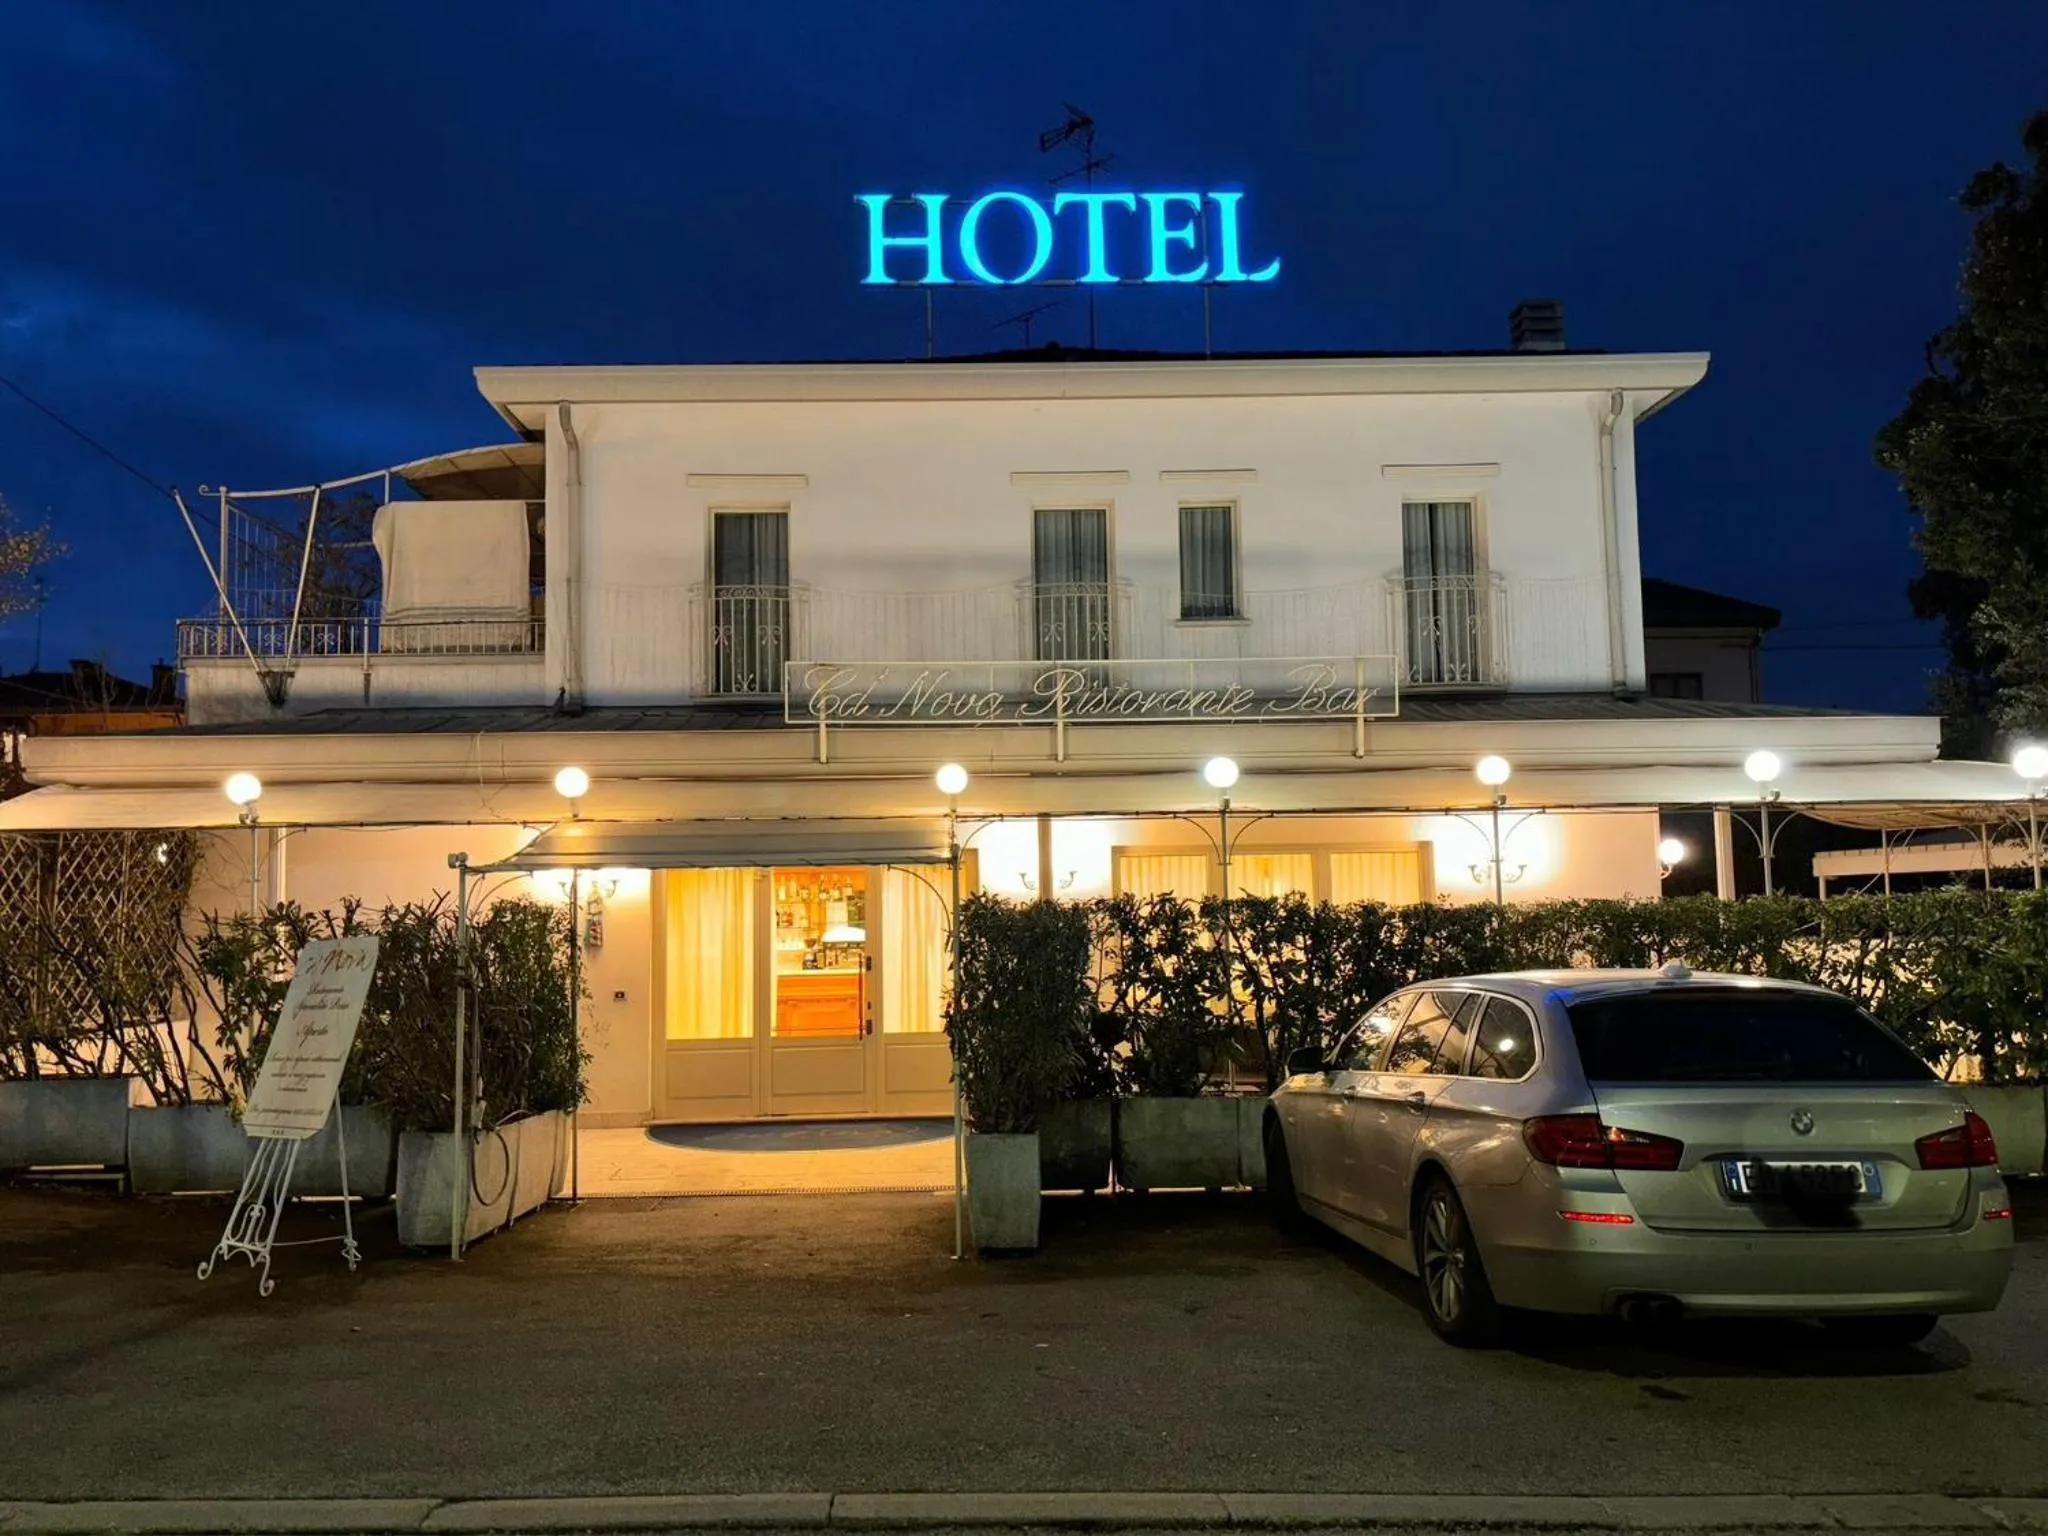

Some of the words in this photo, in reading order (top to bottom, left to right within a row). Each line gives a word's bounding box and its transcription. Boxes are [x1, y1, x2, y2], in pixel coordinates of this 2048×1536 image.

[854, 191, 1280, 285] HOTEL
[879, 670, 1004, 717] Nova
[1020, 668, 1254, 716] Ristorante
[1267, 664, 1380, 713] Bar
